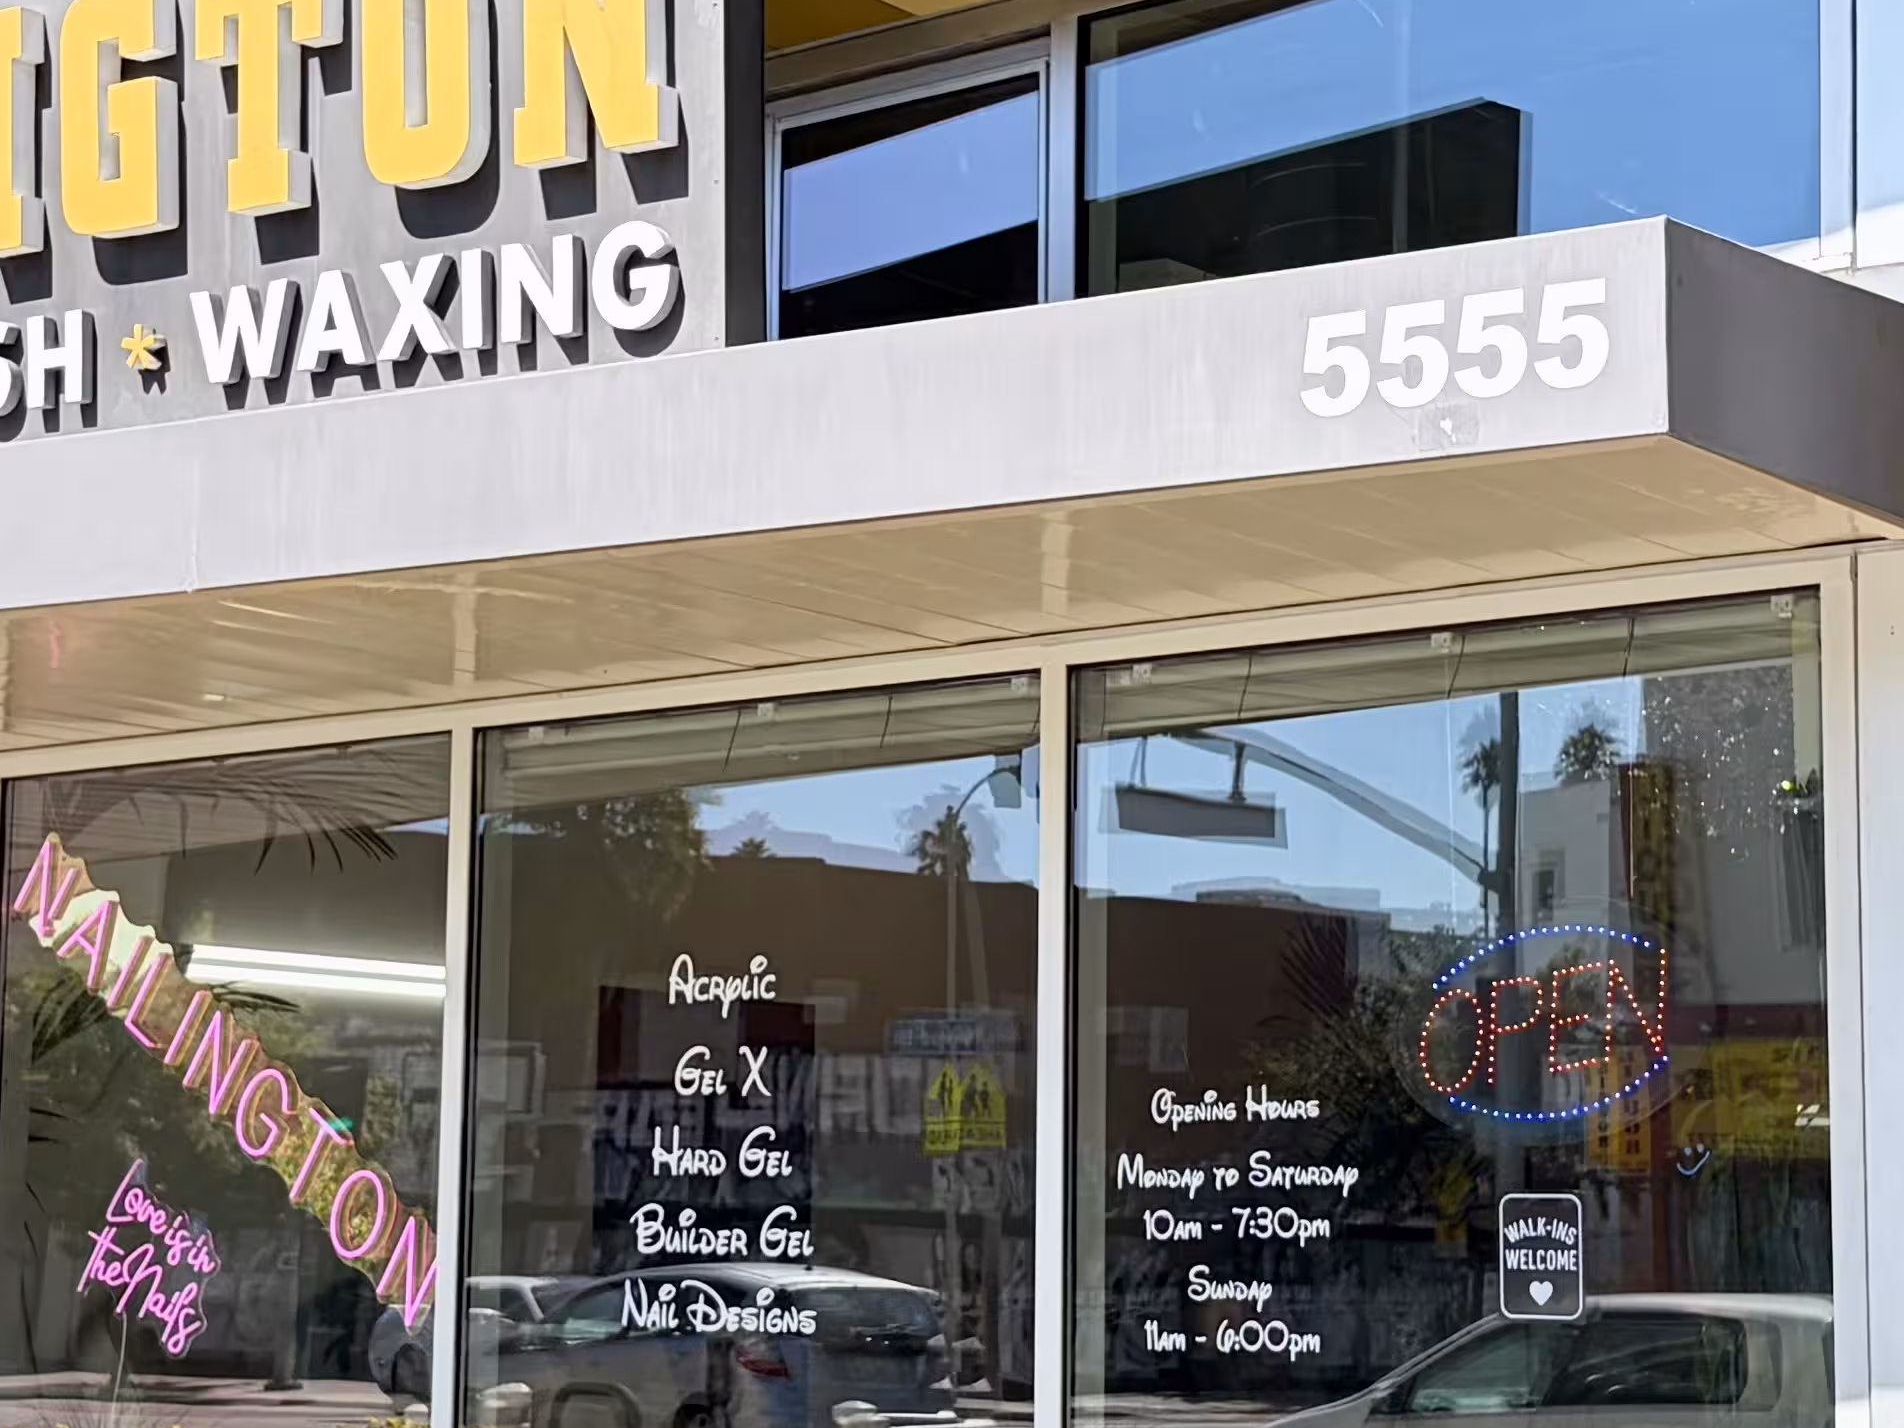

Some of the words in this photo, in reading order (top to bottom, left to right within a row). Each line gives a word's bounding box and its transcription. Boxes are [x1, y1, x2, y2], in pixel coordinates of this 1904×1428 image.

[190, 220, 679, 386] WAXING
[1300, 277, 1610, 418] 5555
[668, 954, 777, 1018] Acrylic
[1419, 947, 1667, 1094] OPEN
[13, 836, 439, 1328] NAILINGTON
[674, 1045, 727, 1097] Gel
[739, 1045, 772, 1097] X
[1151, 1087, 1237, 1132] Opening
[1246, 1084, 1320, 1121] Hours
[652, 1125, 727, 1178] Hard
[739, 1125, 793, 1178] Gel
[1117, 1152, 1204, 1199] Monday
[1248, 1150, 1359, 1197] Saturday
[106, 1158, 169, 1234] Love
[164, 1215, 192, 1266] is
[187, 1234, 215, 1272] in
[629, 1202, 748, 1256] Builder
[760, 1205, 814, 1258] Gel
[1232, 1206, 1331, 1247] 7:30pm
[1503, 1216, 1578, 1245] WALK-INS
[1504, 1248, 1578, 1271] WELCOME
[116, 1243, 201, 1353] Nails
[621, 1276, 679, 1329] Nail
[680, 1279, 818, 1334] Designs
[1187, 1264, 1273, 1313] Sunday
[1216, 1319, 1321, 1362] 6:00pm
